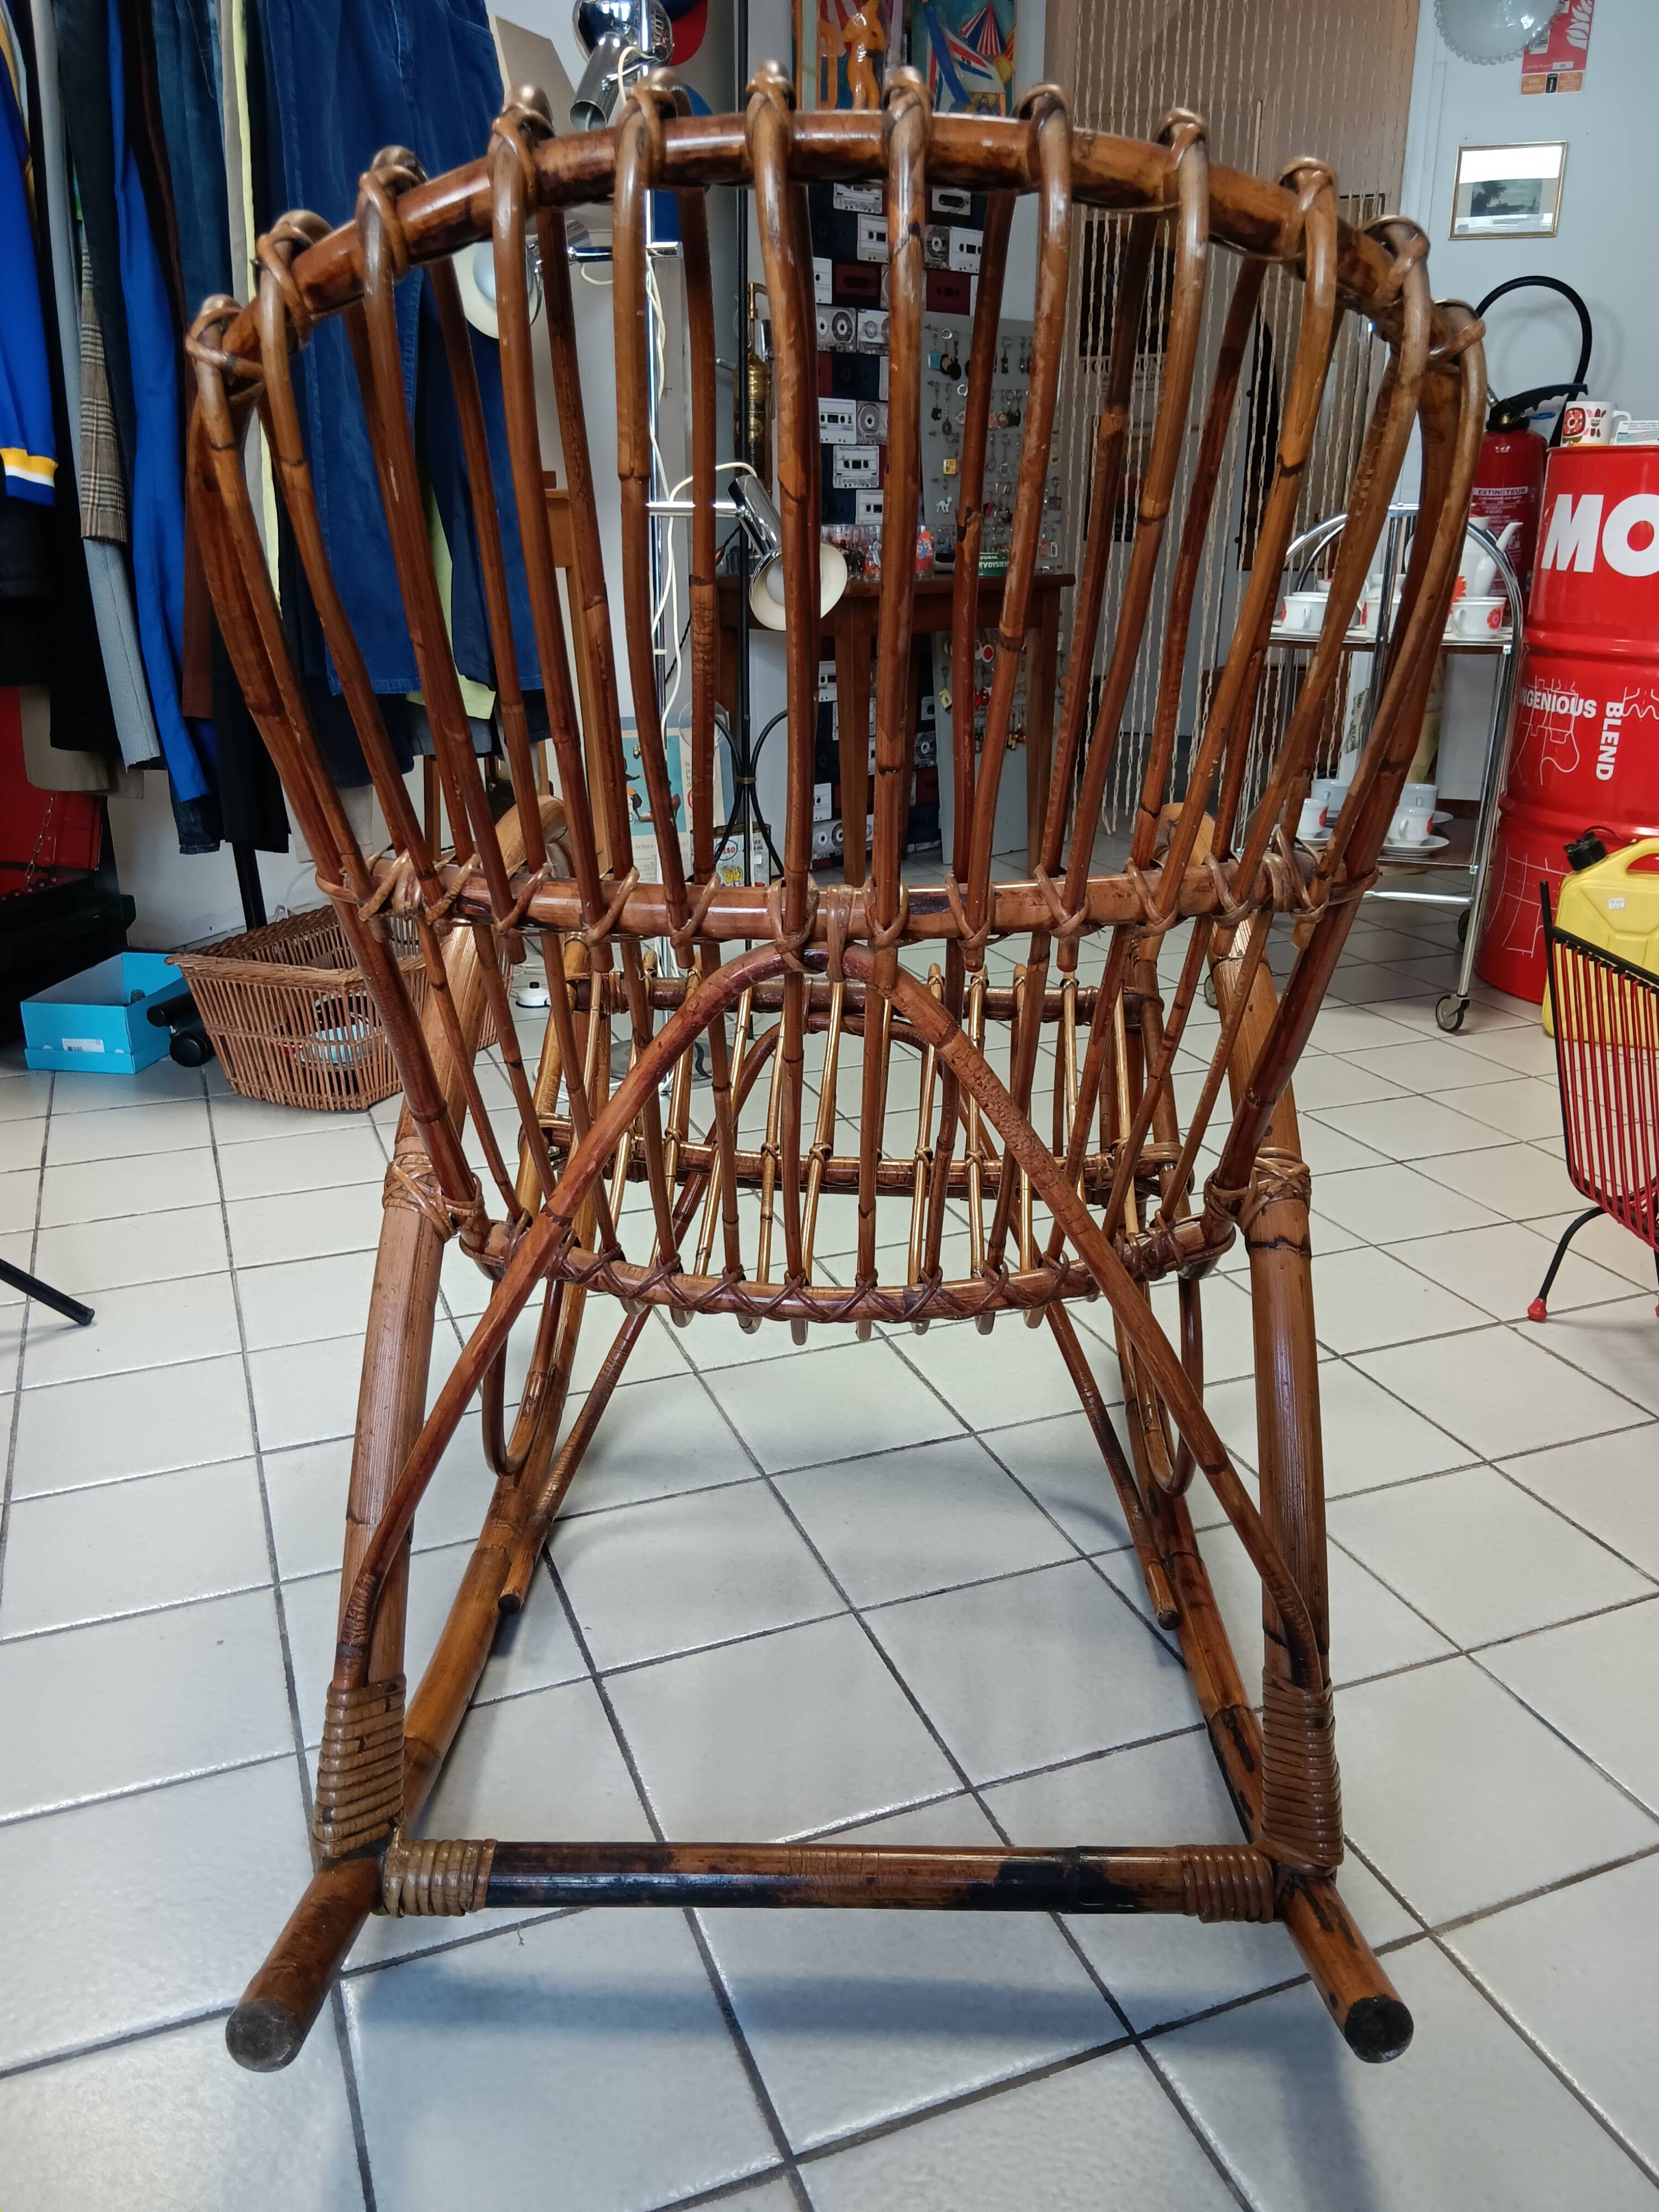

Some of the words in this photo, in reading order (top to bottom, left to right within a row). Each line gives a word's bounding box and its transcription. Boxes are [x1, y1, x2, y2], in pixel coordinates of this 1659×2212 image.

[1478, 487, 1527, 495] EXTINCTEUR
[1541, 493, 1659, 577] MO
[1595, 701, 1625, 781] BLEND
